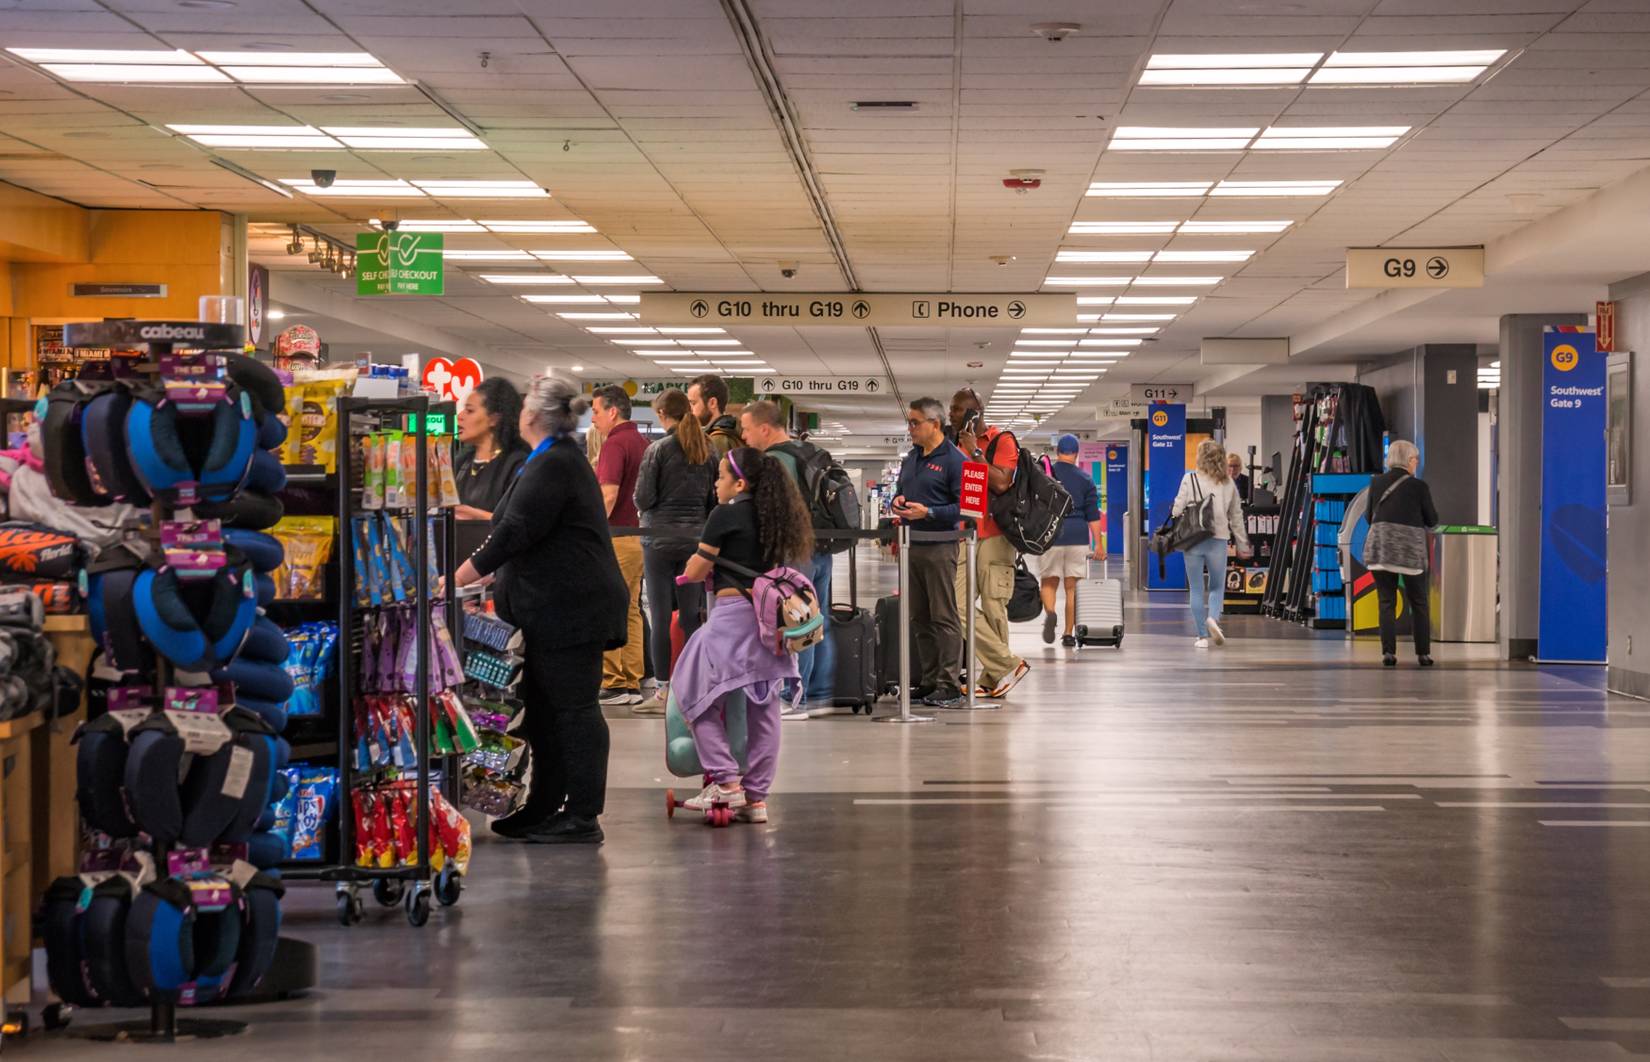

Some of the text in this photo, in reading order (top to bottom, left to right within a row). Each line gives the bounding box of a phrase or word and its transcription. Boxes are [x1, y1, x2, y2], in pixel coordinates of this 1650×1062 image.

[1384, 258, 1416, 277] G9
[362, 271, 378, 280] SELF
[399, 270, 438, 280] CHECKOUT
[718, 301, 843, 317] G10 thru G19
[938, 302, 998, 318] Phone
[141, 323, 204, 339] cabeau
[1556, 351, 1574, 363] G9
[427, 362, 475, 414] ty
[643, 382, 689, 394] MARKE
[782, 380, 859, 391] G10 thru G19
[1551, 386, 1603, 396] Southwest
[1144, 388, 1166, 399] G11
[1551, 398, 1582, 408] Gate 9
[1154, 415, 1167, 423] G11
[963, 469, 985, 480] PLEASE
[964, 482, 983, 492] ENTER
[965, 495, 981, 505] HERE
